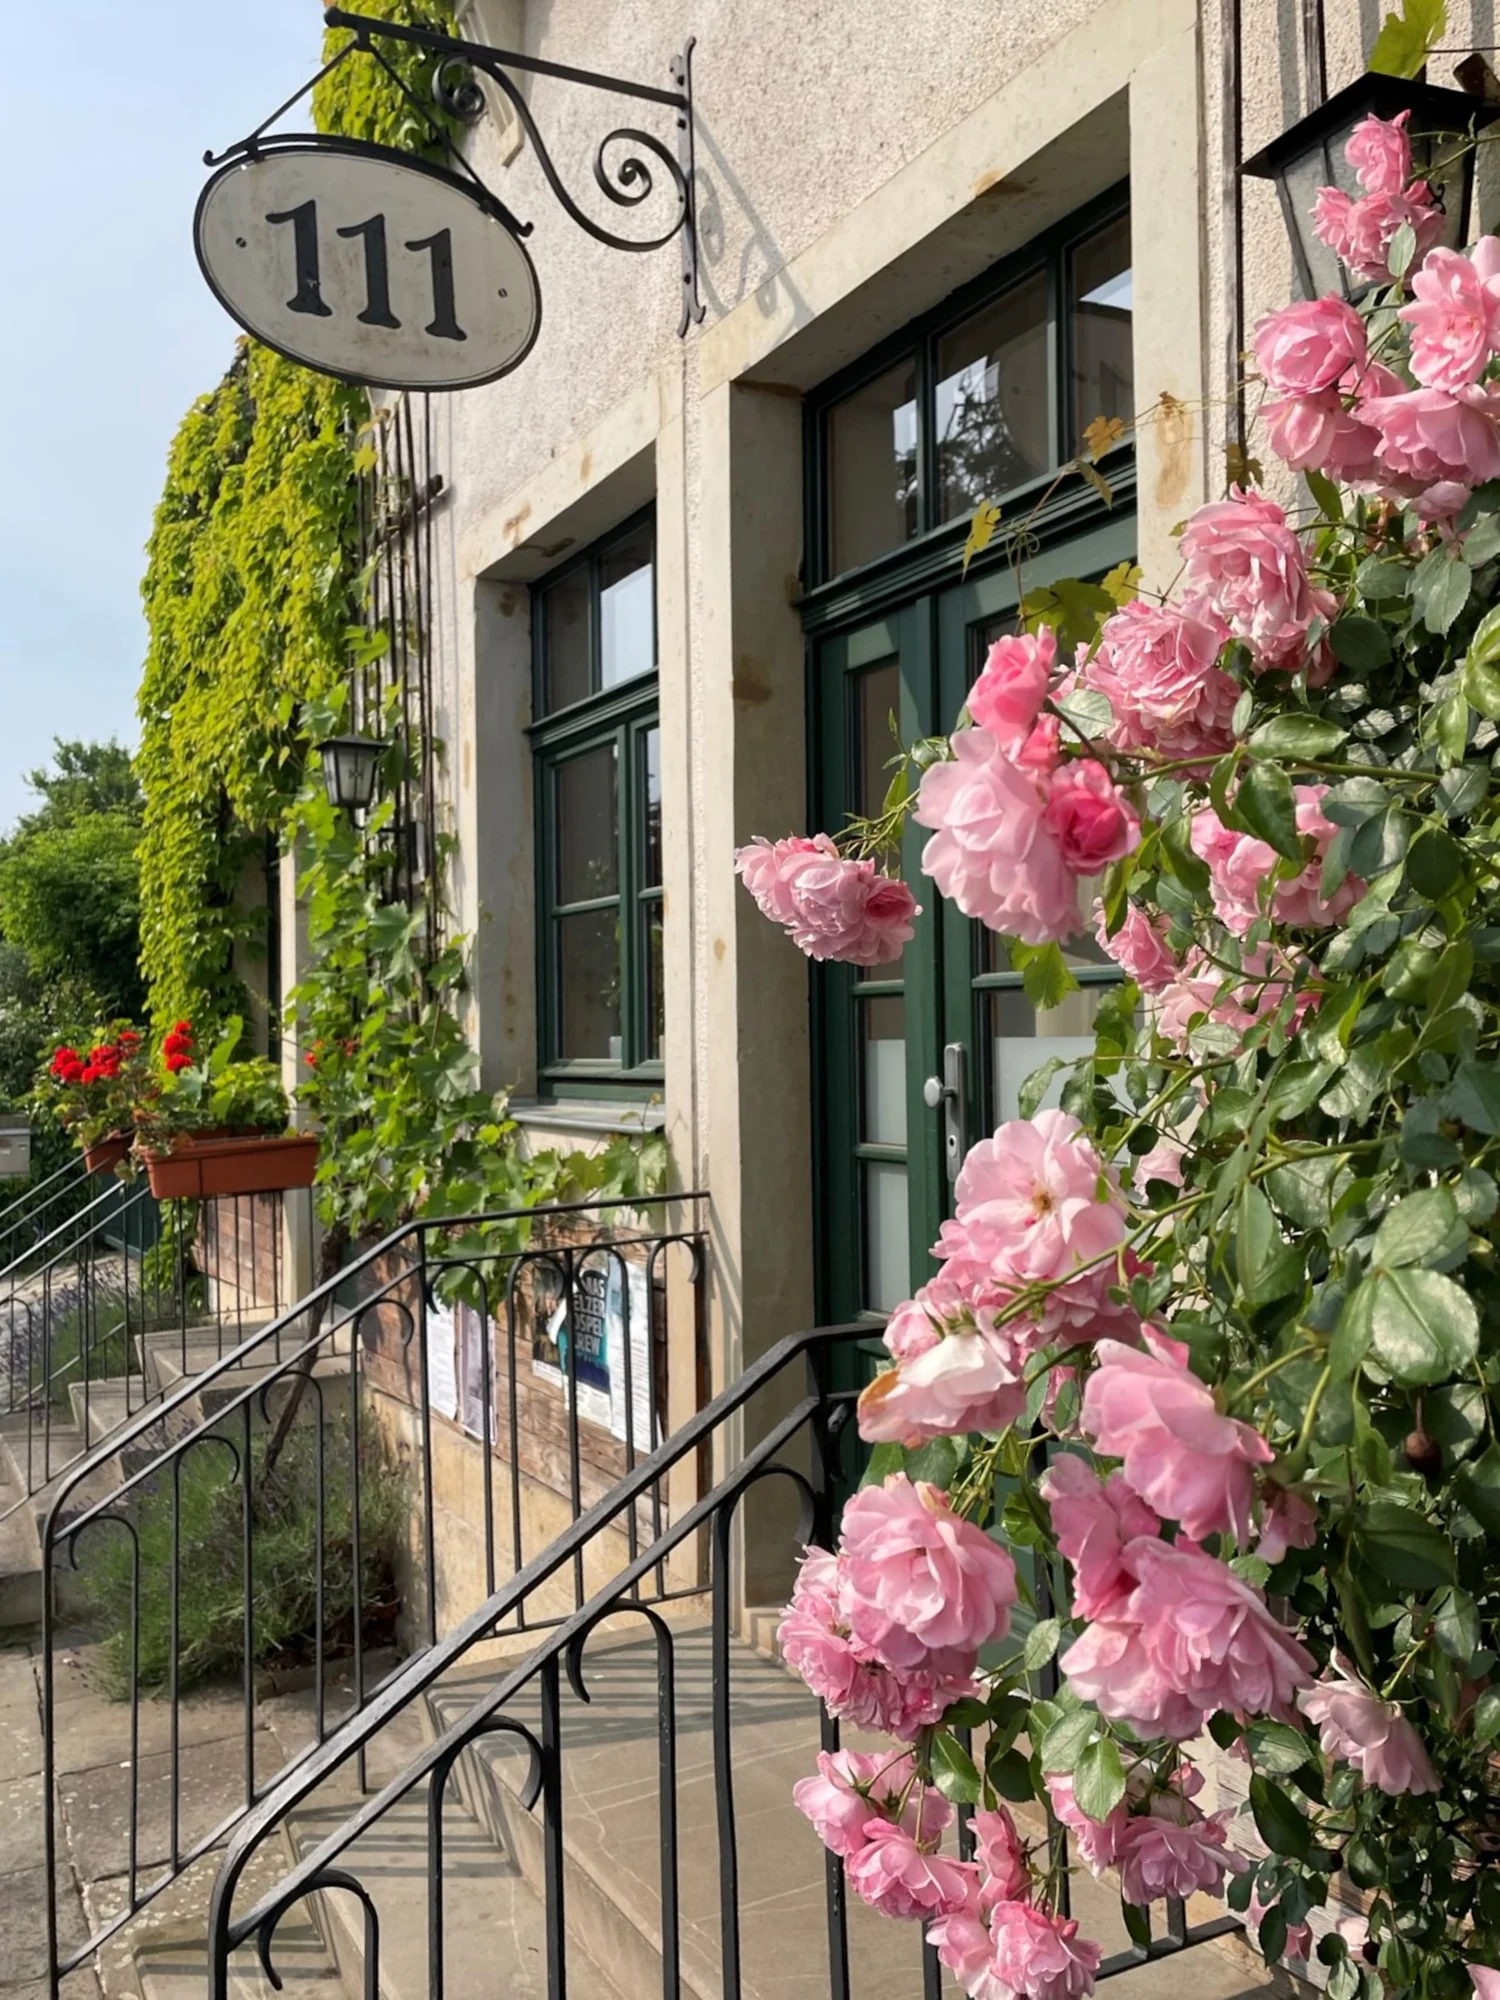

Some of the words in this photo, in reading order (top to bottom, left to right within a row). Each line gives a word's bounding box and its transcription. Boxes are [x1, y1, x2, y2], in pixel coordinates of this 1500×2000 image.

[265, 199, 468, 341] 111
[573, 1293, 607, 1319] ELZER
[574, 1313, 604, 1338] OSPEL
[574, 1332, 601, 1356] REW
